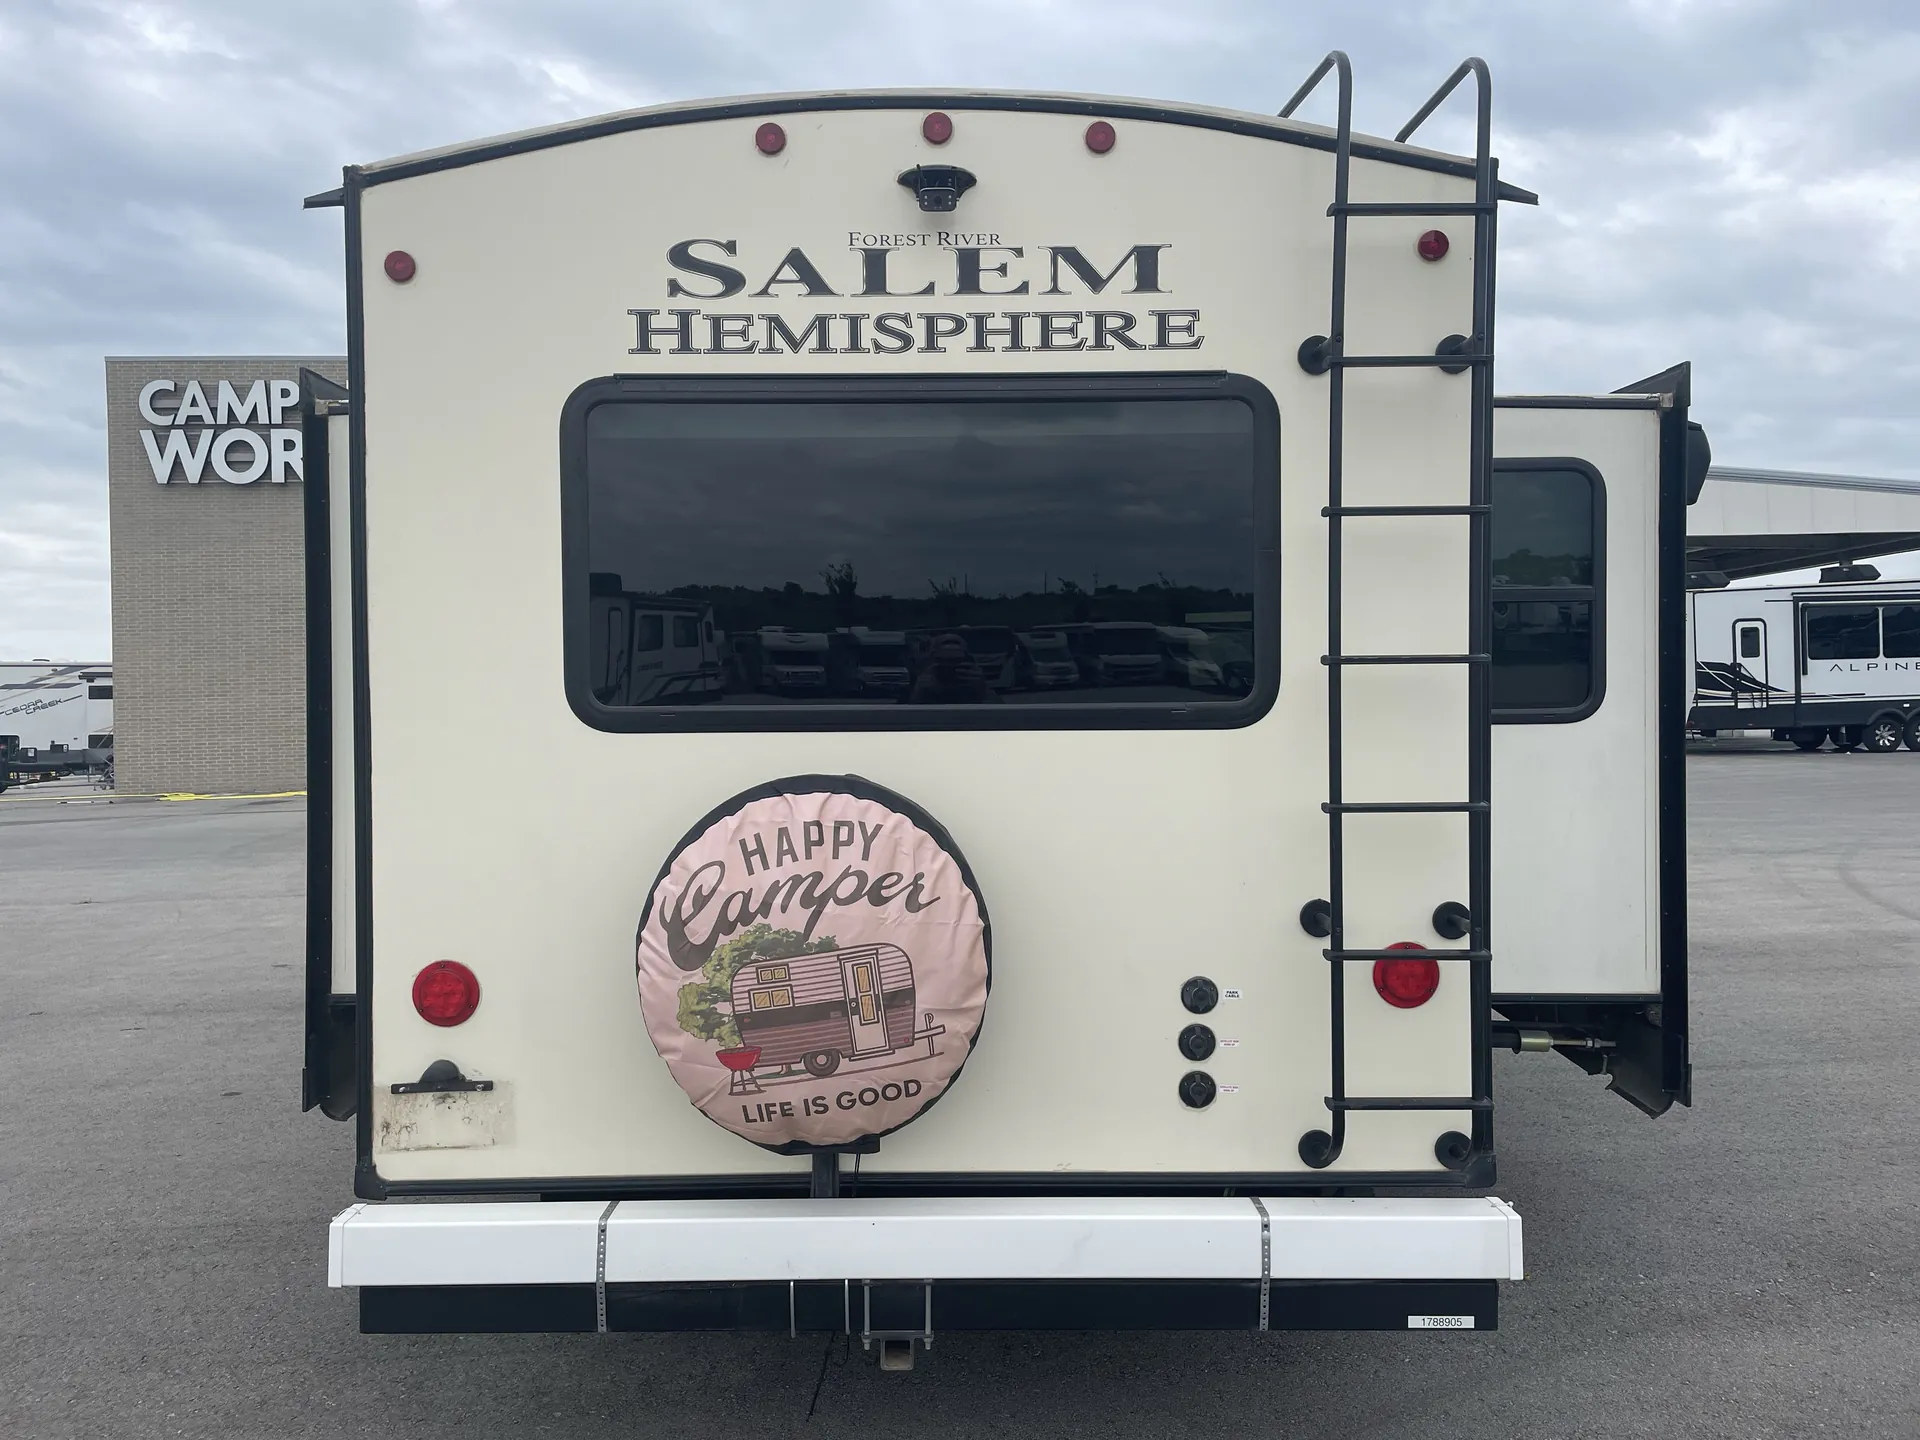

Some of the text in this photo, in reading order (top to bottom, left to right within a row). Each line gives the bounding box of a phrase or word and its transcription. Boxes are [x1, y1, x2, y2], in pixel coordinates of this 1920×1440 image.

[666, 238, 1172, 299] SALEM
[627, 308, 1205, 355] HEMISPHERE
[4, 699, 43, 716] CEDAR
[25, 698, 63, 715] CREEK
[739, 820, 884, 876] HAPPY
[659, 860, 941, 971] Camper
[741, 1079, 922, 1124] LIFE IS GOOD
[1422, 1318, 1463, 1327] 1788905
